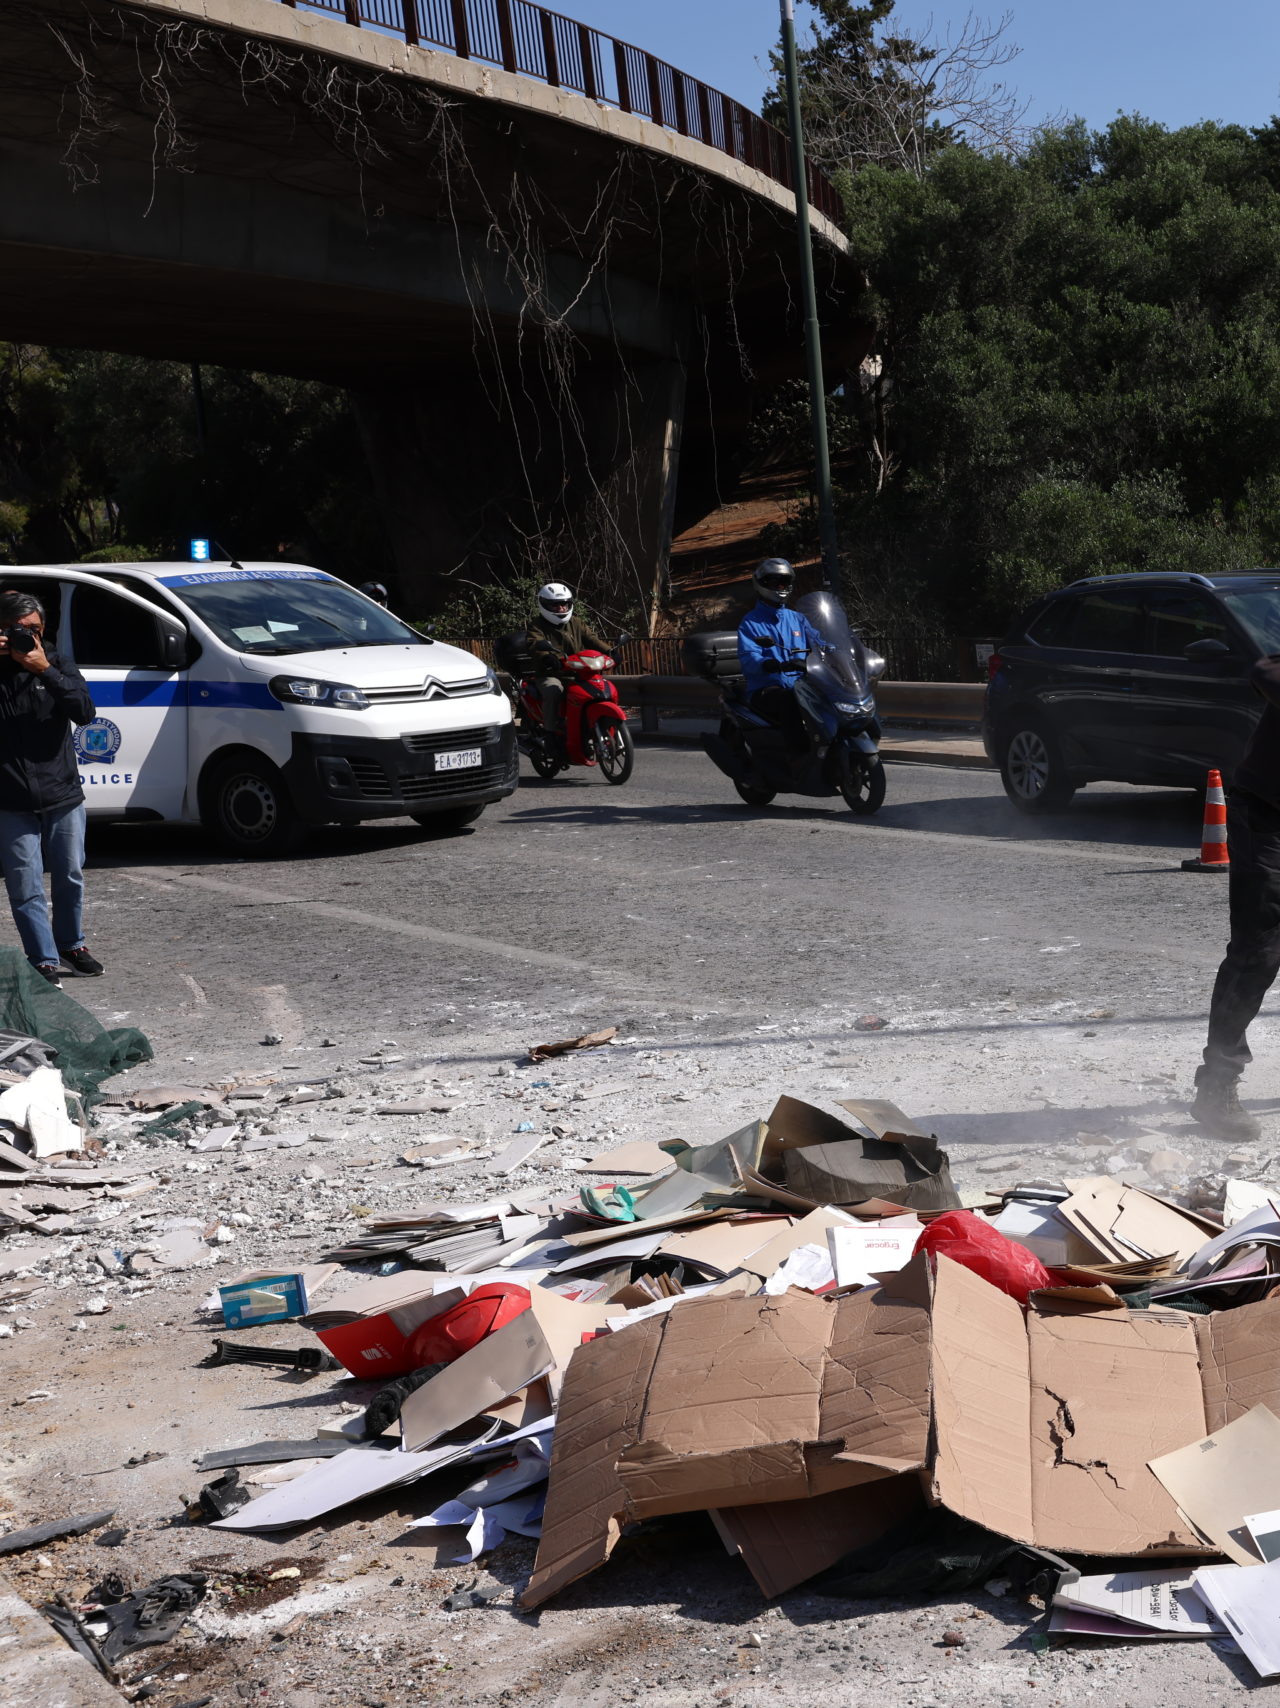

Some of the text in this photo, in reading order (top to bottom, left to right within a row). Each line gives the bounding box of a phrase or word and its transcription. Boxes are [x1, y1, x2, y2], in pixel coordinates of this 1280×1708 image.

[182, 572, 250, 585] ΕΛΛΗΝΙΚΗ
[80, 773, 133, 785] OLICE
[864, 1242, 900, 1250] Ergocar
